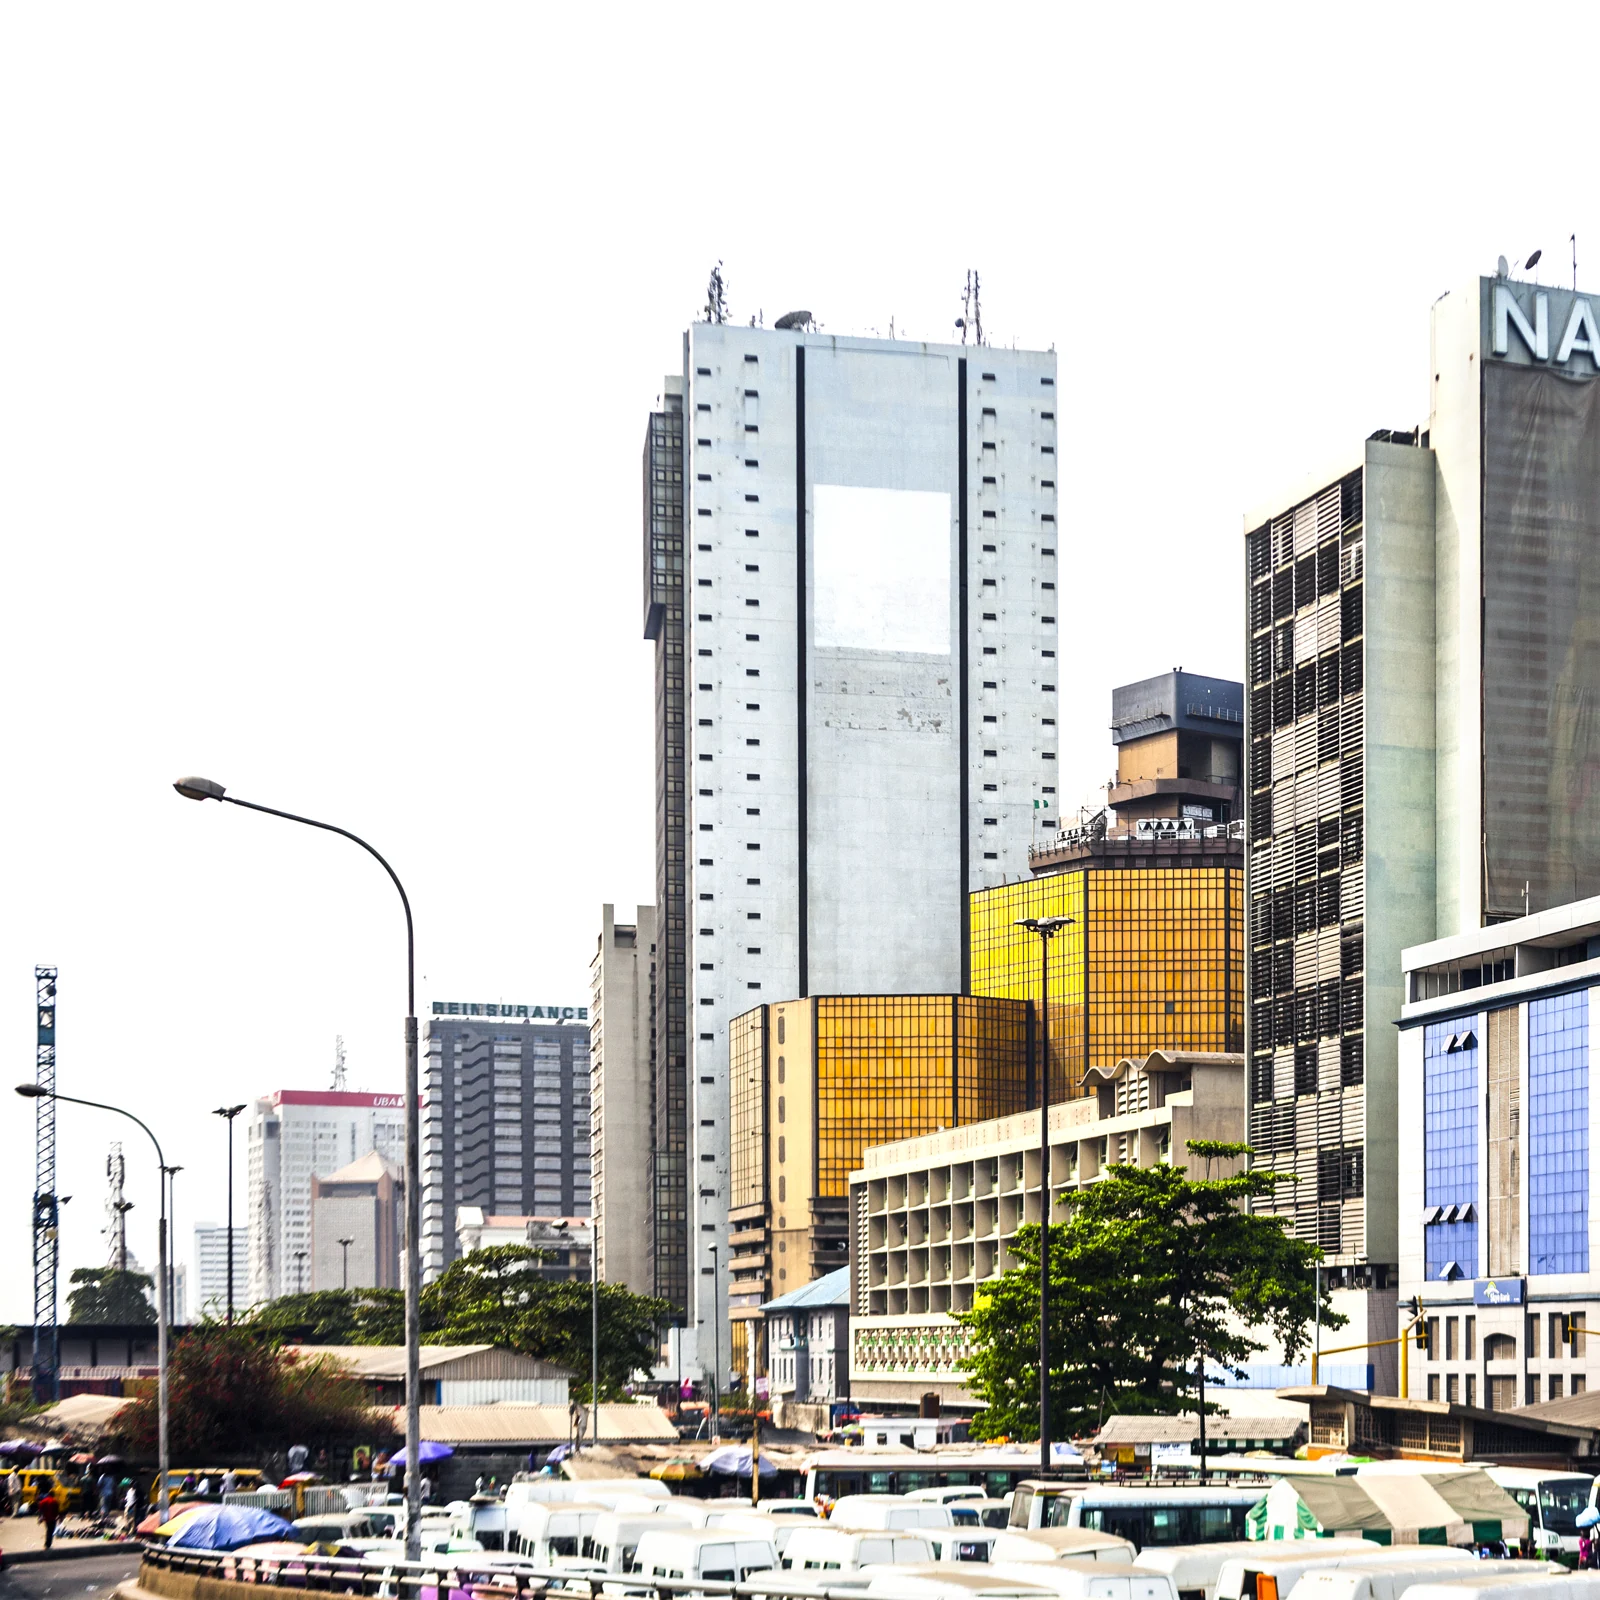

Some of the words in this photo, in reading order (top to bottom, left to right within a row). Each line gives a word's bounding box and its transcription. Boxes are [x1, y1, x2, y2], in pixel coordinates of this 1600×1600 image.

[1492, 283, 1600, 368] NA
[432, 1001, 588, 1020] REINSURANCE
[373, 1096, 397, 1106] UBA
